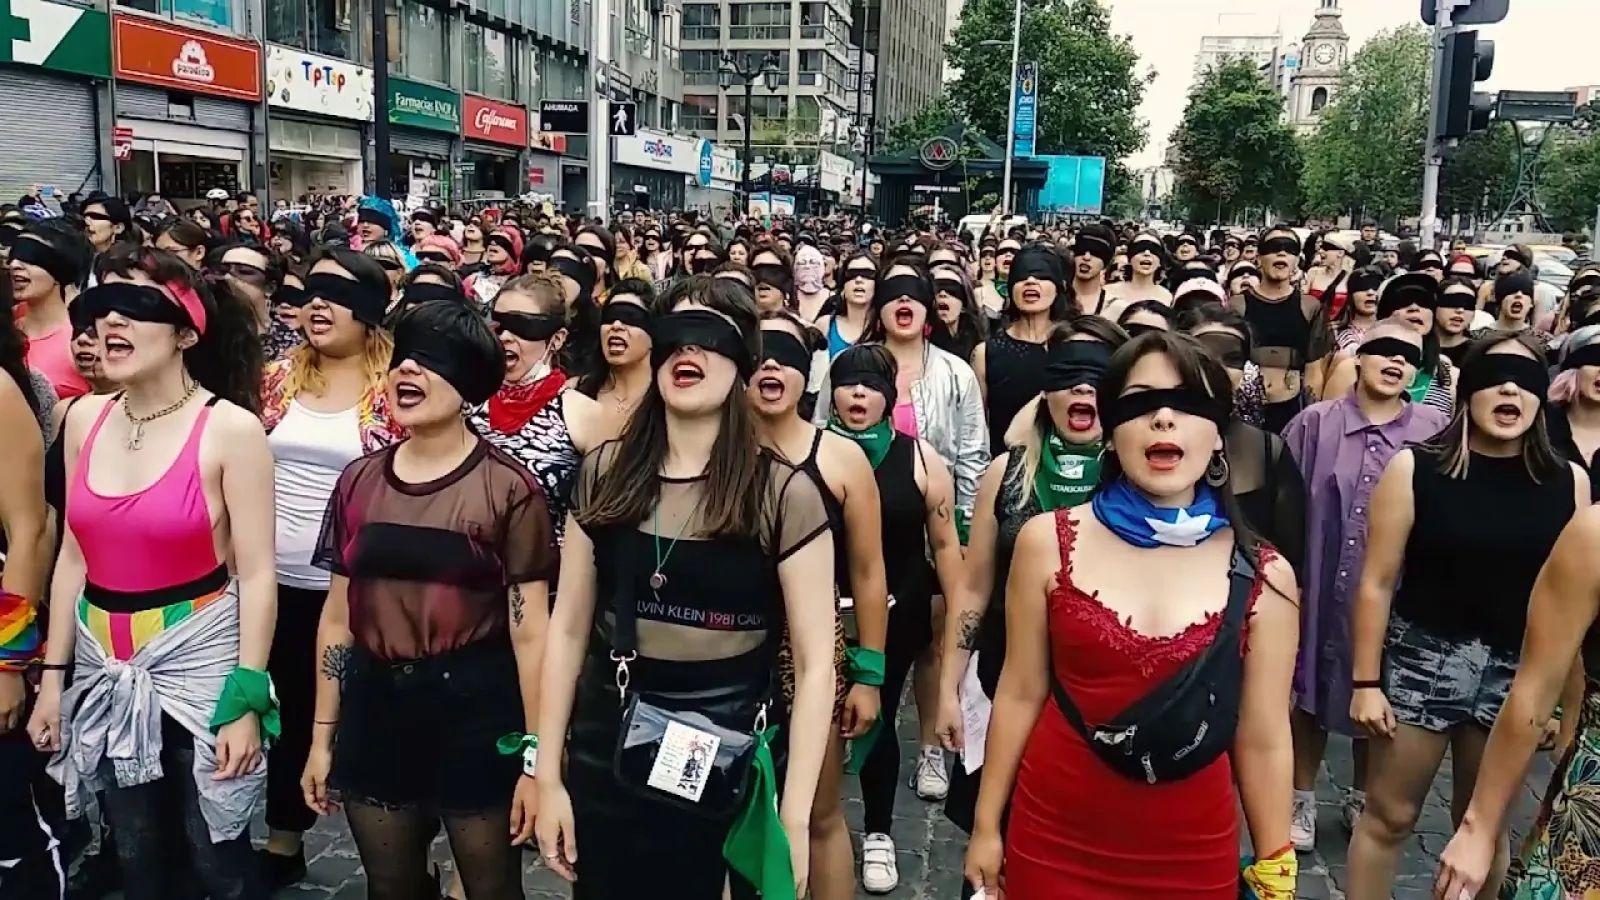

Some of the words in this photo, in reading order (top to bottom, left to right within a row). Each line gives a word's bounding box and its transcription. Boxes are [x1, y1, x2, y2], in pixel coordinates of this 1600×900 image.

[395, 92, 434, 112] Farmacias
[543, 103, 579, 112] AHUMADA
[667, 605, 704, 623] KLEIN
[709, 611, 735, 626] 1981
